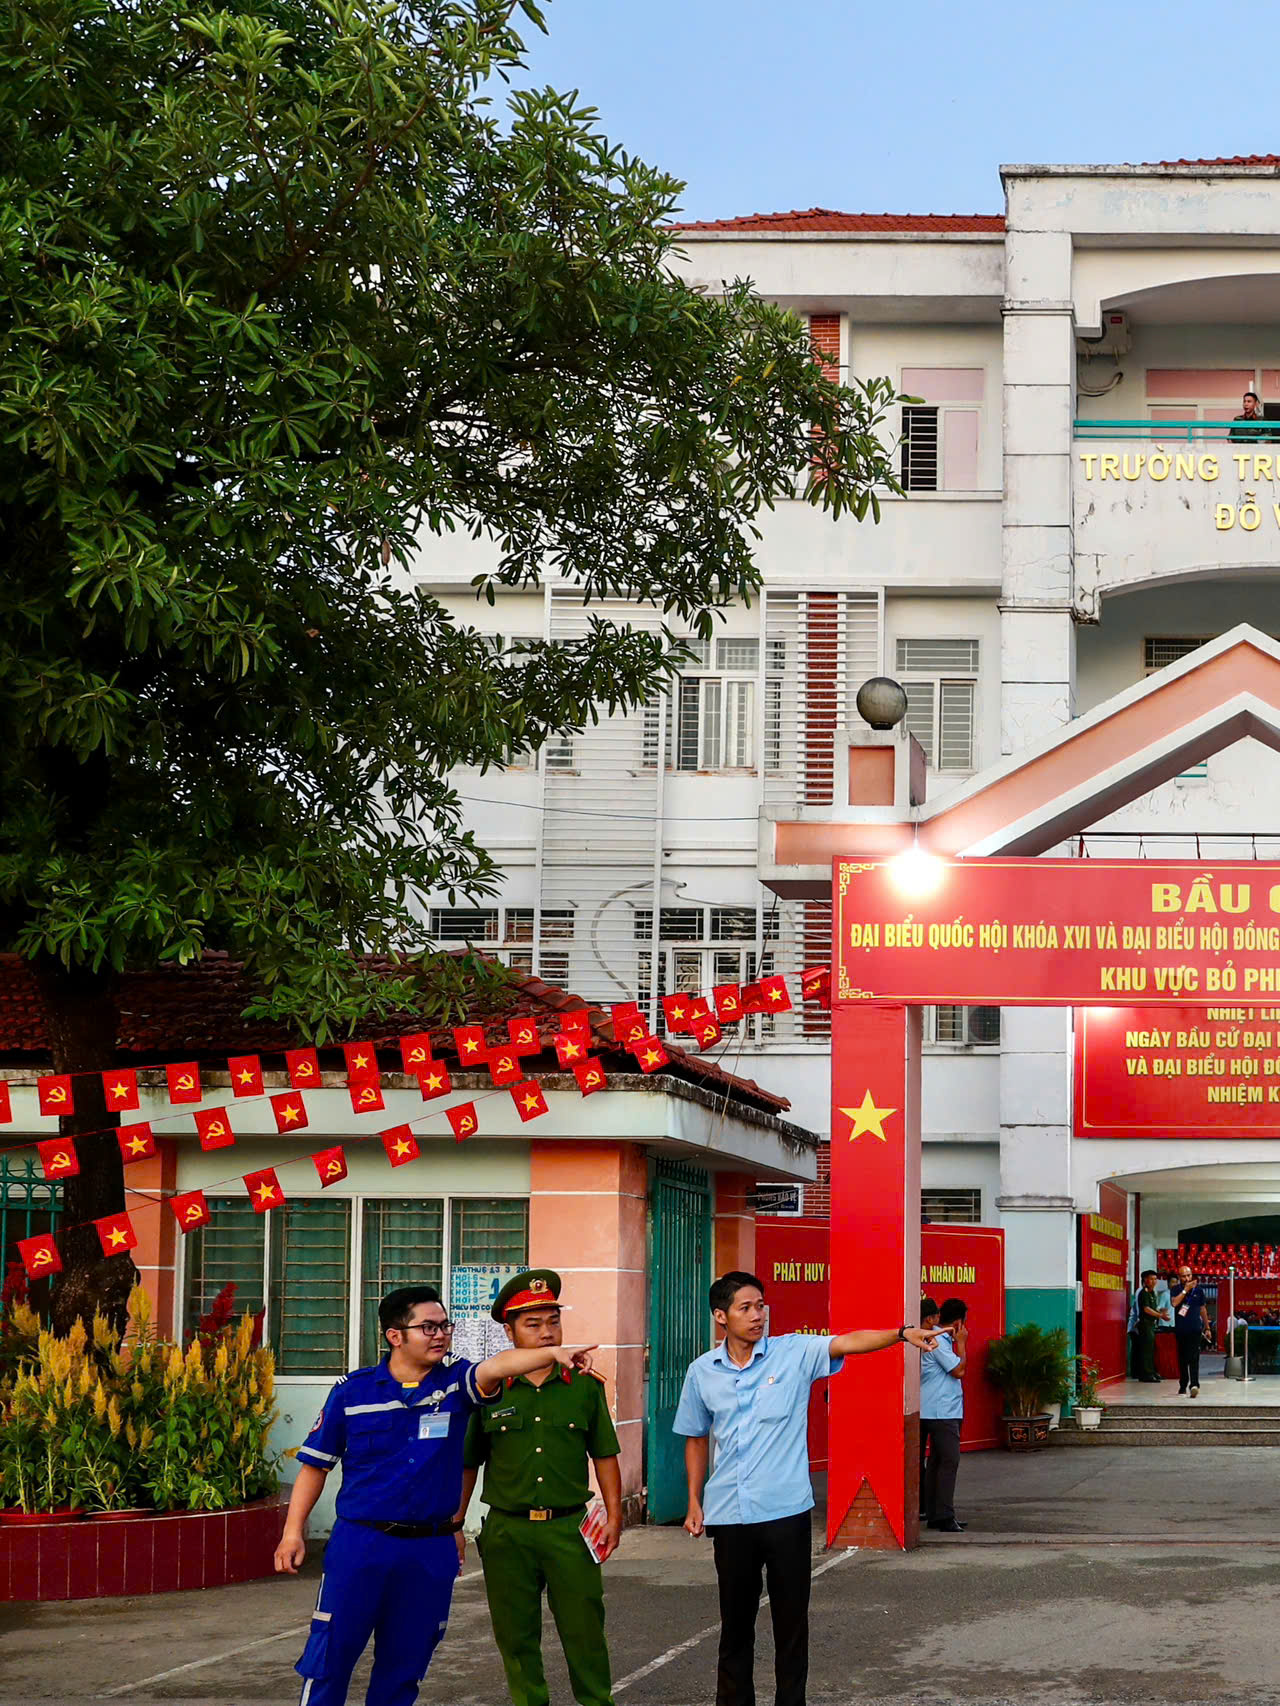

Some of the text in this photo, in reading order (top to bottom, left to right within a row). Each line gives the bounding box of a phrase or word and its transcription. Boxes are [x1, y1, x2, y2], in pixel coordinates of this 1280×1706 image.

[1080, 443, 1220, 482] TRƯỜNG
[1215, 491, 1262, 532] ĐỖ
[1152, 873, 1250, 914] BẦU
[850, 924, 880, 953] ĐẠI
[885, 914, 924, 950] BIỂU
[929, 916, 974, 953] QUỐC
[979, 920, 1008, 954] HỘI
[1013, 921, 1059, 949] KHÓA
[1064, 926, 1091, 949] XVI
[1095, 921, 1118, 950] VÀ
[1122, 925, 1151, 955] ĐẠI
[1156, 917, 1195, 951] BIỂU
[1199, 922, 1228, 956] HỘI
[1232, 919, 1280, 951] ĐỒNG
[1100, 967, 1147, 991] KHU
[1153, 965, 1198, 996] VỰC
[1206, 963, 1237, 992] BỎ
[1125, 1028, 1172, 1048] NGÀY
[1177, 1026, 1211, 1048] BẦU
[1215, 1026, 1241, 1048] CỬ
[1243, 1031, 1272, 1051] ĐẠI
[1126, 1055, 1149, 1075] VÀ
[1152, 1058, 1182, 1078] ĐẠI
[1186, 1053, 1226, 1075] BIỂU
[1230, 1055, 1259, 1079] HỘI
[1207, 1082, 1263, 1106] NHIỆM
[773, 1258, 801, 1282] PHÁT
[804, 1263, 825, 1282] HUY
[929, 1261, 955, 1283] NHÂN
[957, 1262, 976, 1284] DÂN
